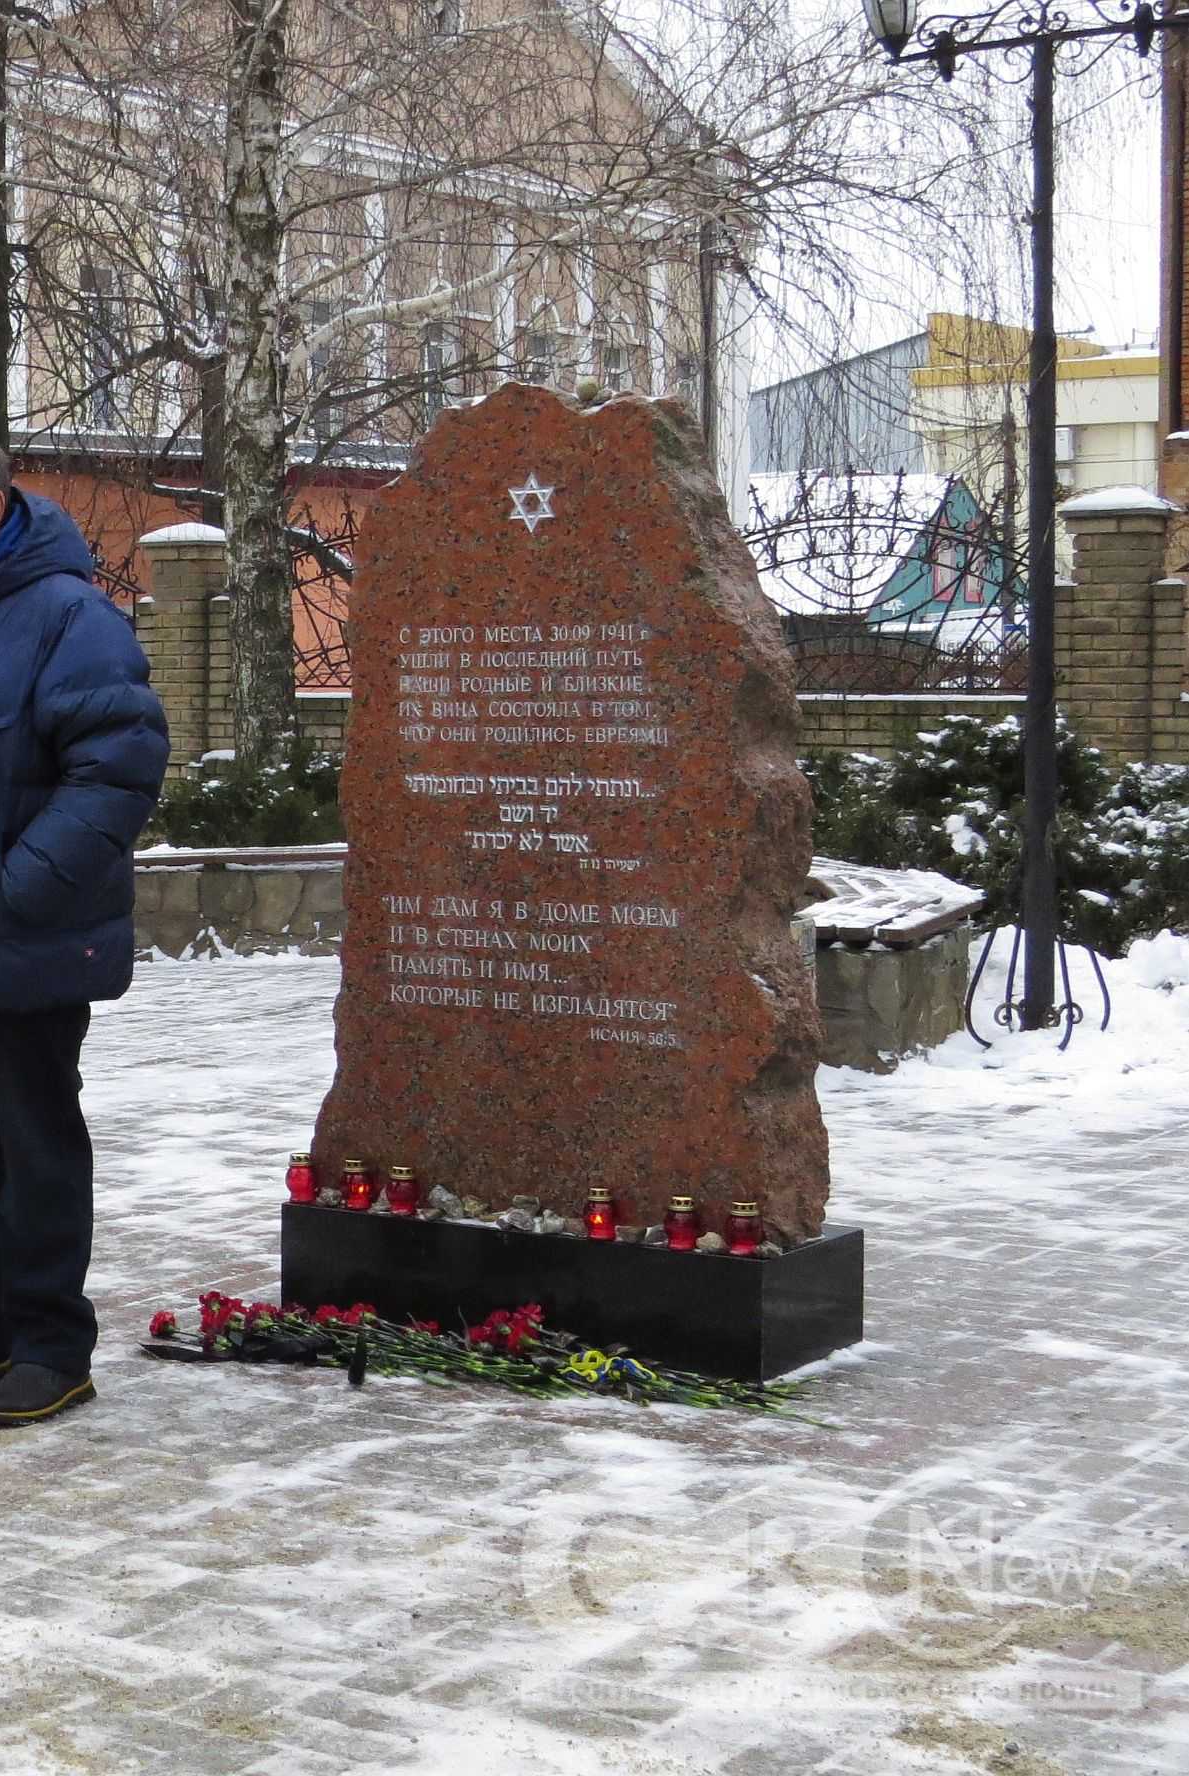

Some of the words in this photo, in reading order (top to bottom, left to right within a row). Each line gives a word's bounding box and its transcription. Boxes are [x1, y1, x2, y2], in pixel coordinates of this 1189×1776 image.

[399, 627, 410, 643] С
[419, 627, 474, 644] ЭТОГО
[484, 626, 543, 642] МЕСТА
[600, 624, 632, 641] 1941
[400, 653, 450, 668] УШЛИ
[459, 652, 471, 668] В
[480, 648, 587, 668] ПОСЛЕДНИЙ
[596, 650, 643, 666] ПУТЬ
[399, 675, 450, 693] НАШИ
[460, 676, 532, 694] РОДНЫЕ
[542, 676, 552, 692] И
[398, 701, 422, 717] ИХ
[432, 701, 478, 718] ВИНА
[489, 701, 581, 718] СОСТОЯЛА
[592, 702, 603, 717] В
[399, 726, 432, 742] ЧТО
[440, 726, 477, 742] ОНИ
[484, 727, 576, 743] РОДИЛИСЬ
[585, 727, 668, 745] ЕВРЕЯМИ
[489, 775, 539, 795] בביתי
[545, 772, 582, 796] להם
[499, 804, 533, 823] ושם
[540, 807, 558, 823] יד
[519, 828, 543, 852] לא
[431, 897, 478, 918] ДАМ
[488, 900, 502, 919] Я
[515, 901, 528, 920] В
[540, 903, 600, 923] ДОМЕ
[612, 906, 678, 927] МОЕМ
[390, 926, 404, 943] И
[416, 927, 428, 944] В
[437, 928, 518, 950] СТЕНАХ
[527, 933, 592, 953] МОИХ
[391, 954, 472, 977] ПАМЯТЬ
[479, 960, 492, 978] И
[390, 984, 483, 1008] КОТОРЫЕ
[494, 992, 520, 1010] НЕ
[590, 1027, 640, 1044] ИСАИЯ
